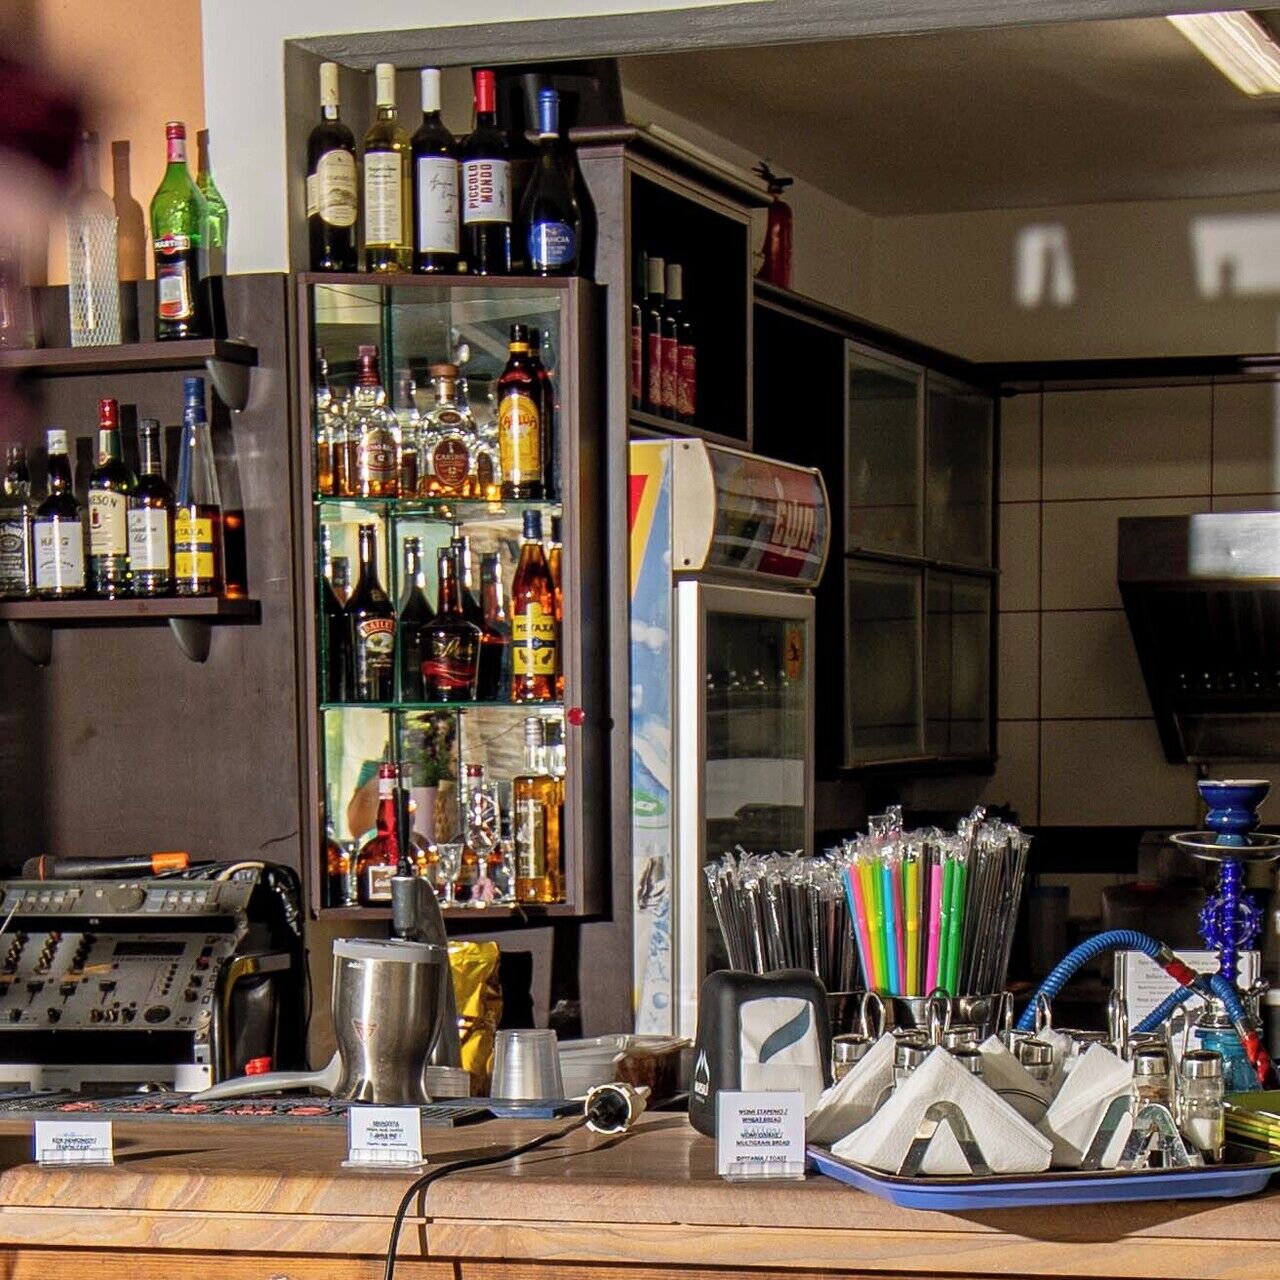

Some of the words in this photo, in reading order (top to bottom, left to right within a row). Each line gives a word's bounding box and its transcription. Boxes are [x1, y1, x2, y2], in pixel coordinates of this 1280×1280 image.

[468, 164, 479, 209] PICCOLO
[480, 163, 493, 203] MONDO
[516, 623, 556, 632] METAXA
